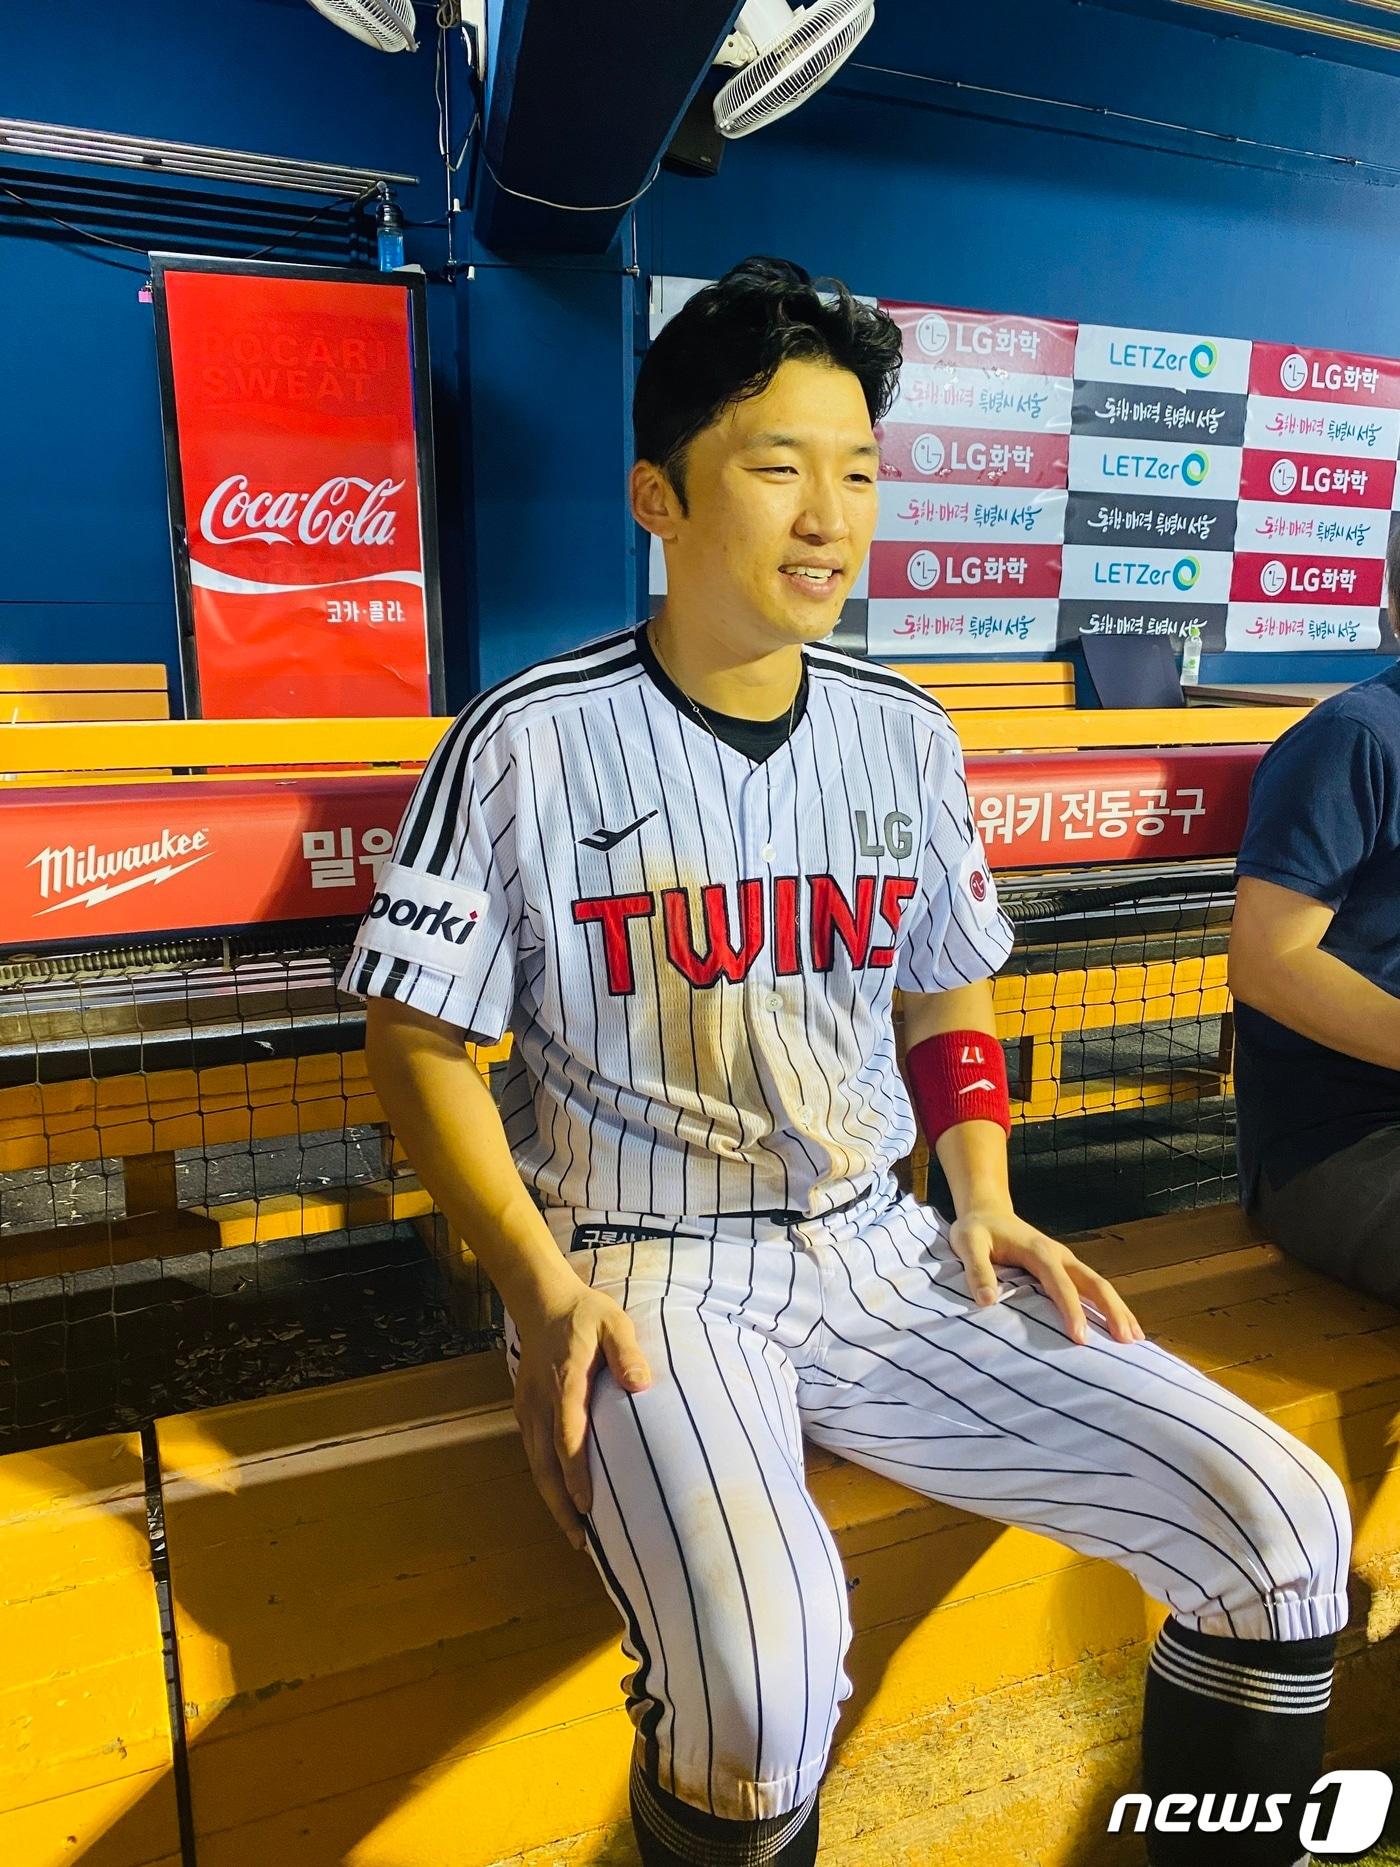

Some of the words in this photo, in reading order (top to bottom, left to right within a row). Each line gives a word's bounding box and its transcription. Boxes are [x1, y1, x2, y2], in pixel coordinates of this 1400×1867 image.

[956, 322, 1040, 359] LG화학
[1311, 362, 1380, 394] LG화학
[950, 441, 1034, 474] LG화학
[1300, 465, 1369, 495] LG화학
[945, 556, 1028, 585] LG화학
[1290, 566, 1357, 594] LG화학
[967, 791, 1052, 844] 워키
[1059, 788, 1206, 841] 전동공구
[854, 809, 914, 860] LG
[25, 828, 210, 899] Milwaukee
[571, 873, 919, 997] TWINS
